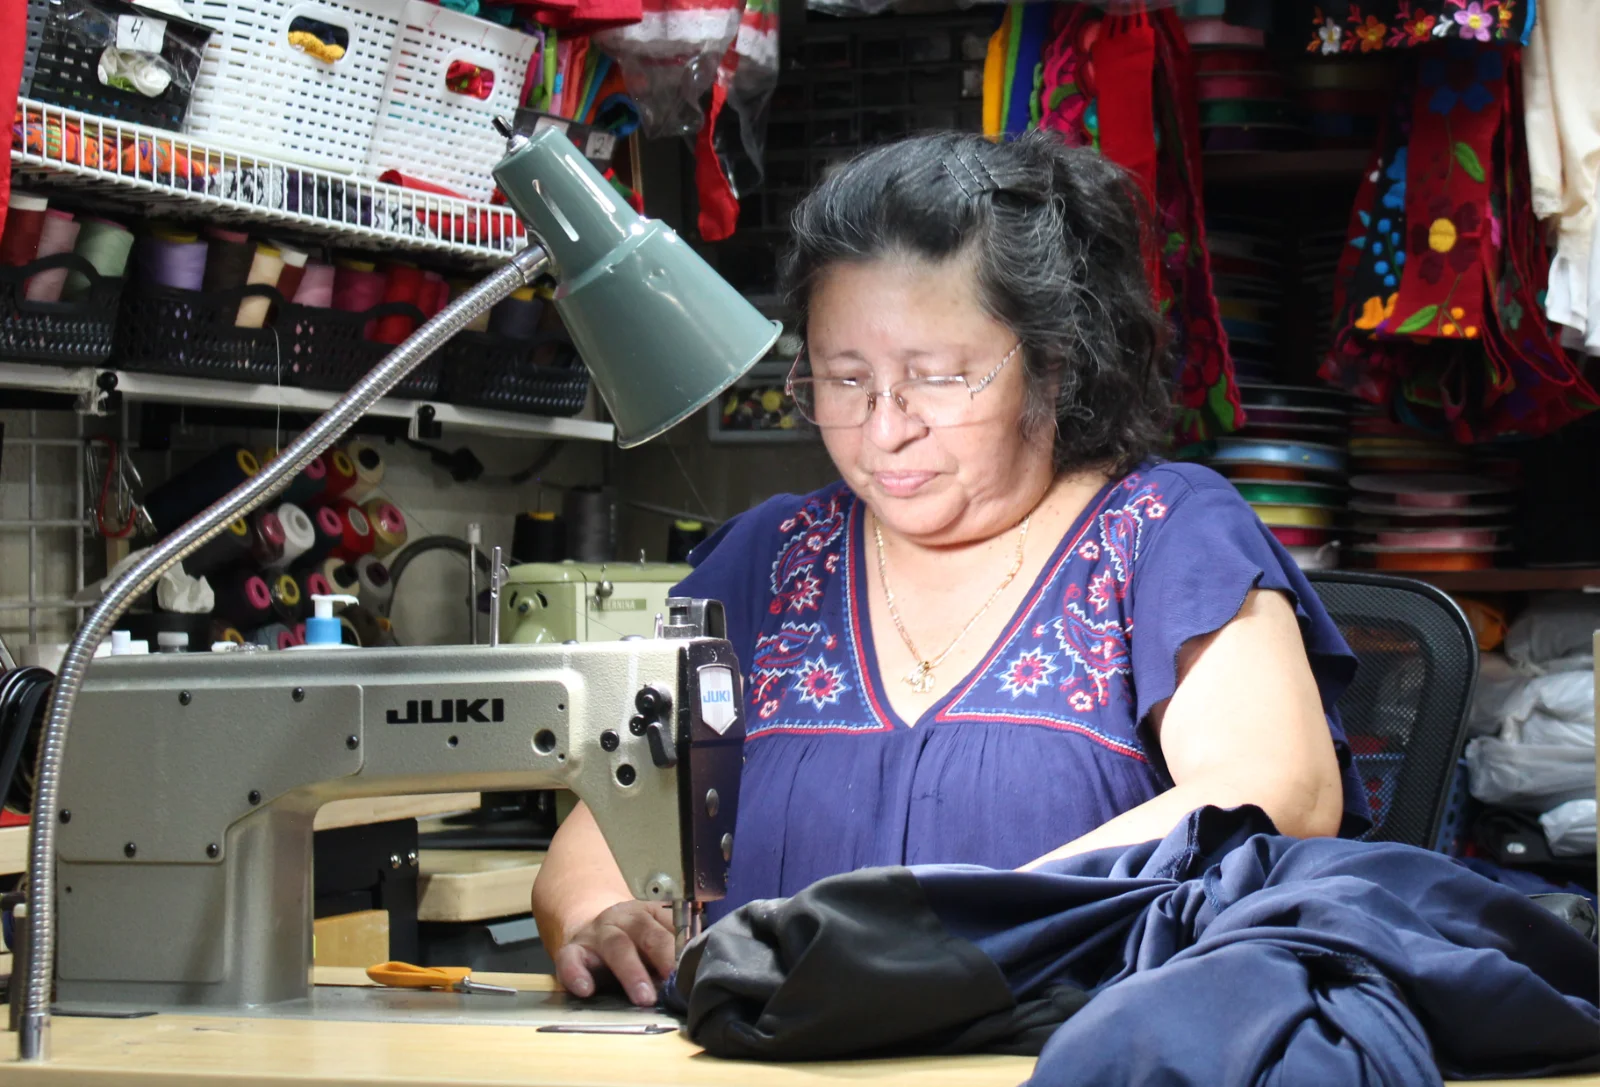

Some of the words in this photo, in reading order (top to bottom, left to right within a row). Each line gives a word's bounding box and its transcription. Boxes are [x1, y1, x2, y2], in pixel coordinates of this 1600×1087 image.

[130, 18, 144, 42] 4
[703, 689, 731, 703] JUKI
[386, 698, 504, 724] JUKI
